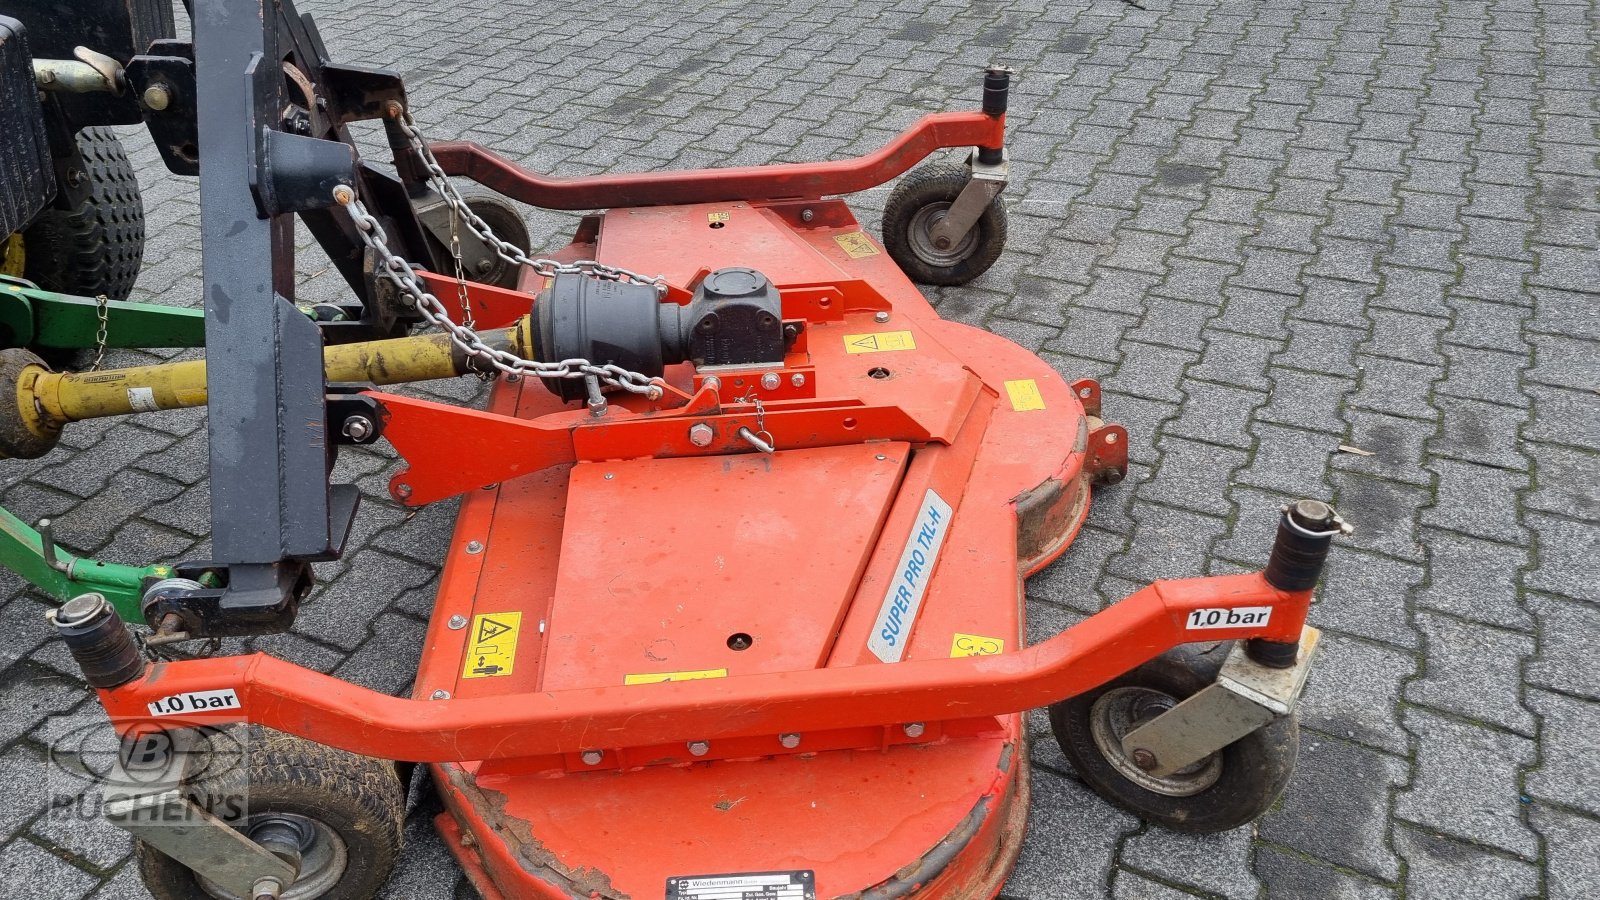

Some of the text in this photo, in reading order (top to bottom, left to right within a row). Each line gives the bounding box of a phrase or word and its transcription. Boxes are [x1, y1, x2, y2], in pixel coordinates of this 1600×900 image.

[881, 505, 942, 647] SUPER PRO TXL-H
[1192, 609, 1268, 627] 1,0 bar
[189, 694, 234, 710] bar
[692, 879, 743, 888] Wiedenmann
